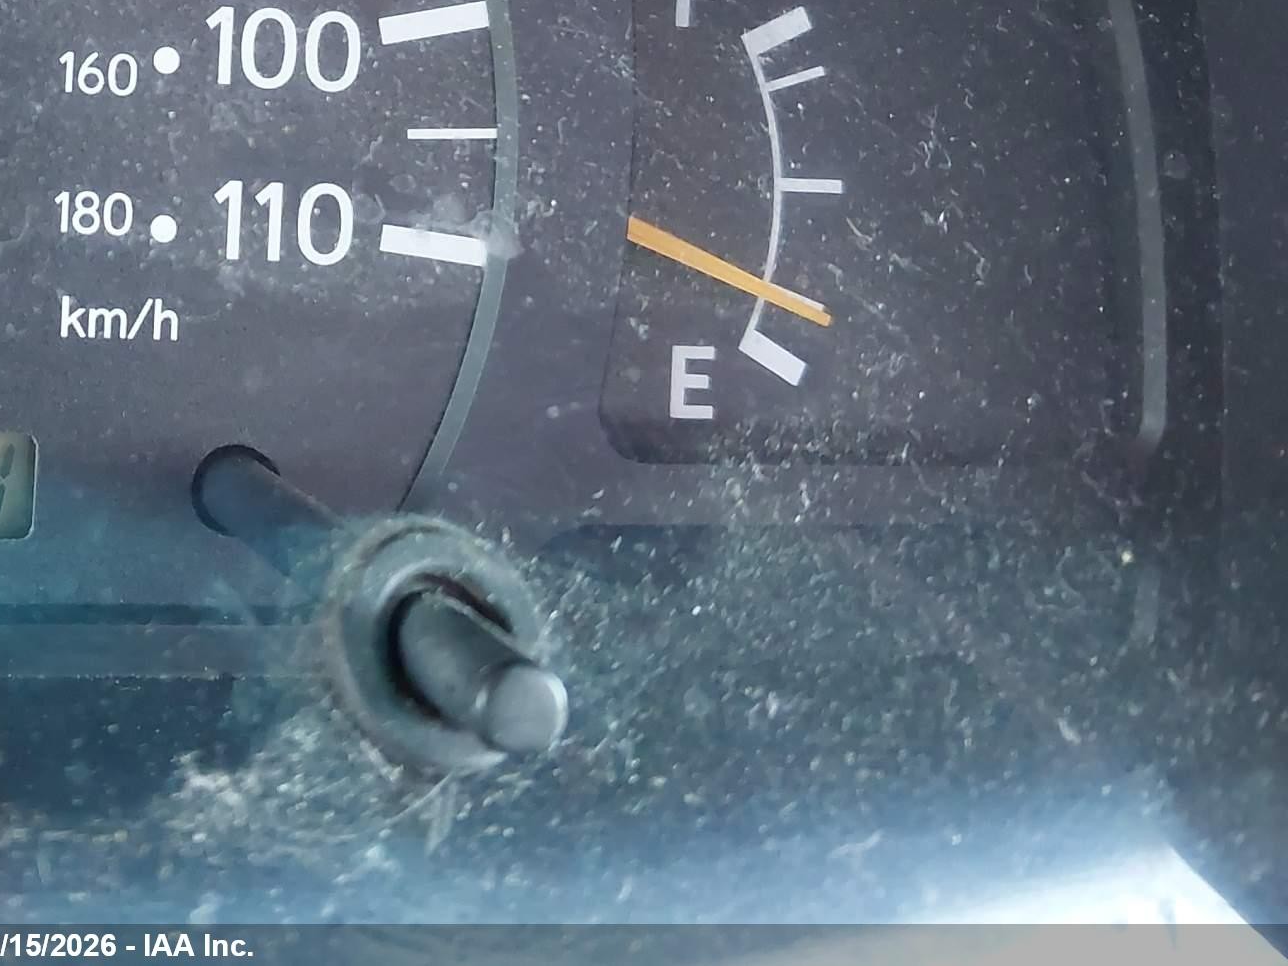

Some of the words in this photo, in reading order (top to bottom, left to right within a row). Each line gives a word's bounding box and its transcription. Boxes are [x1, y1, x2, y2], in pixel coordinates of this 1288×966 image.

[60, 52, 137, 96] 160
[206, 7, 360, 92] 100
[55, 191, 133, 236] 180
[215, 181, 353, 265] 110
[61, 296, 178, 341] km/h
[670, 345, 714, 418] E
